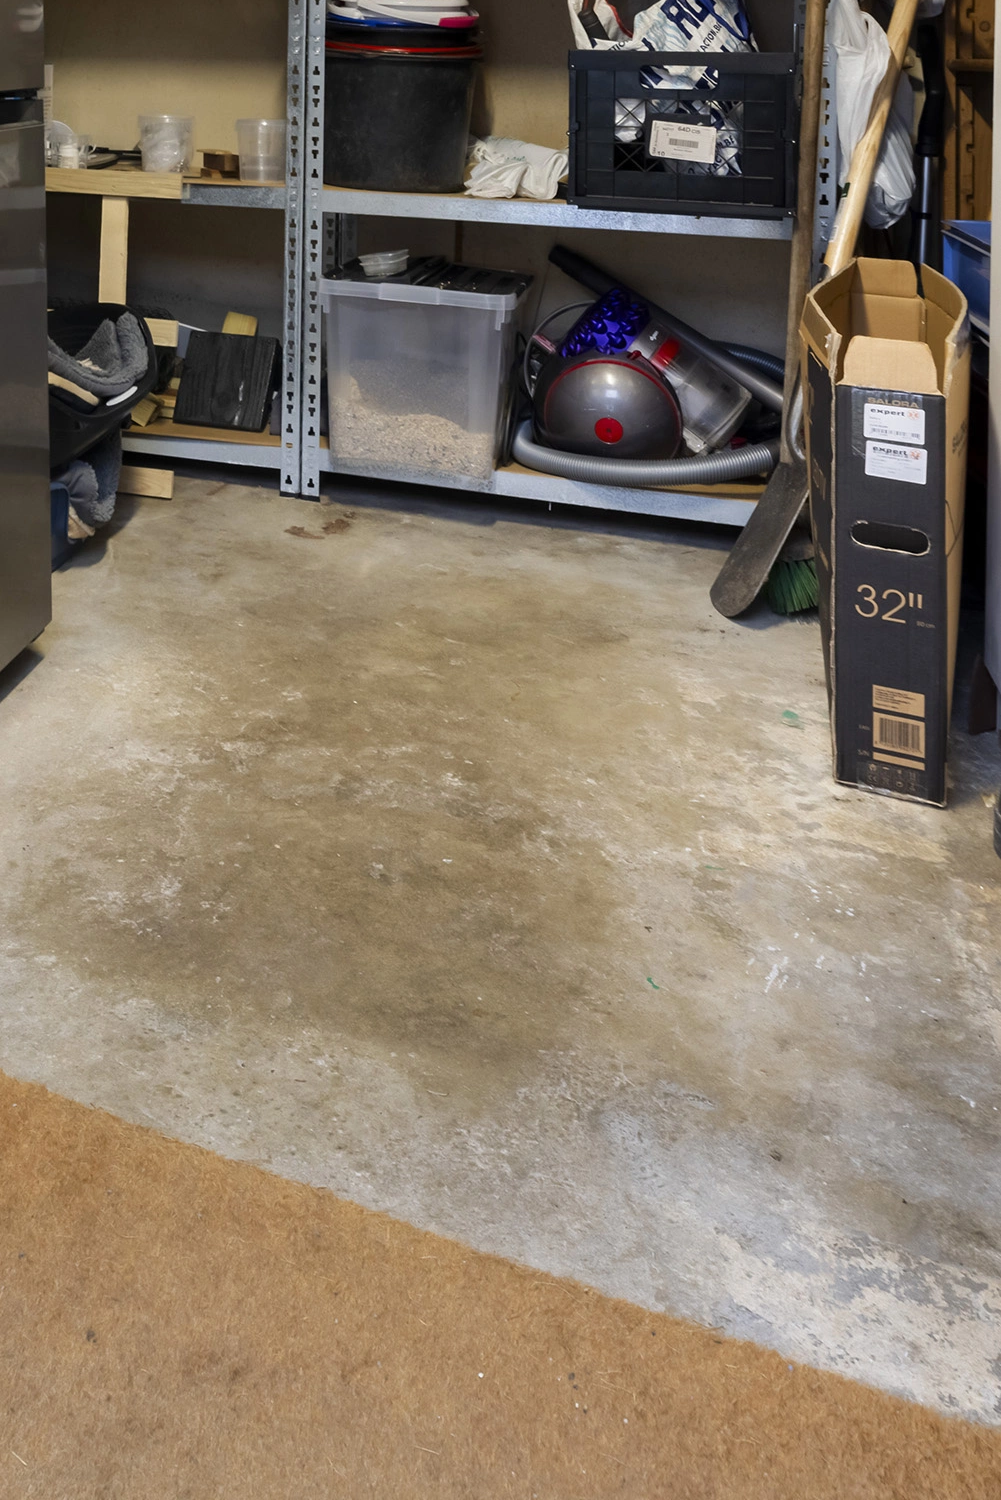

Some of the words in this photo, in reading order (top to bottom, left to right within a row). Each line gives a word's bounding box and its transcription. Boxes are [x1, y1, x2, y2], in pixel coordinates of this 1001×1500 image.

[867, 397, 919, 409] SALORA
[870, 408, 905, 417] expert
[872, 445, 908, 456] expert
[855, 583, 923, 624] 32"
